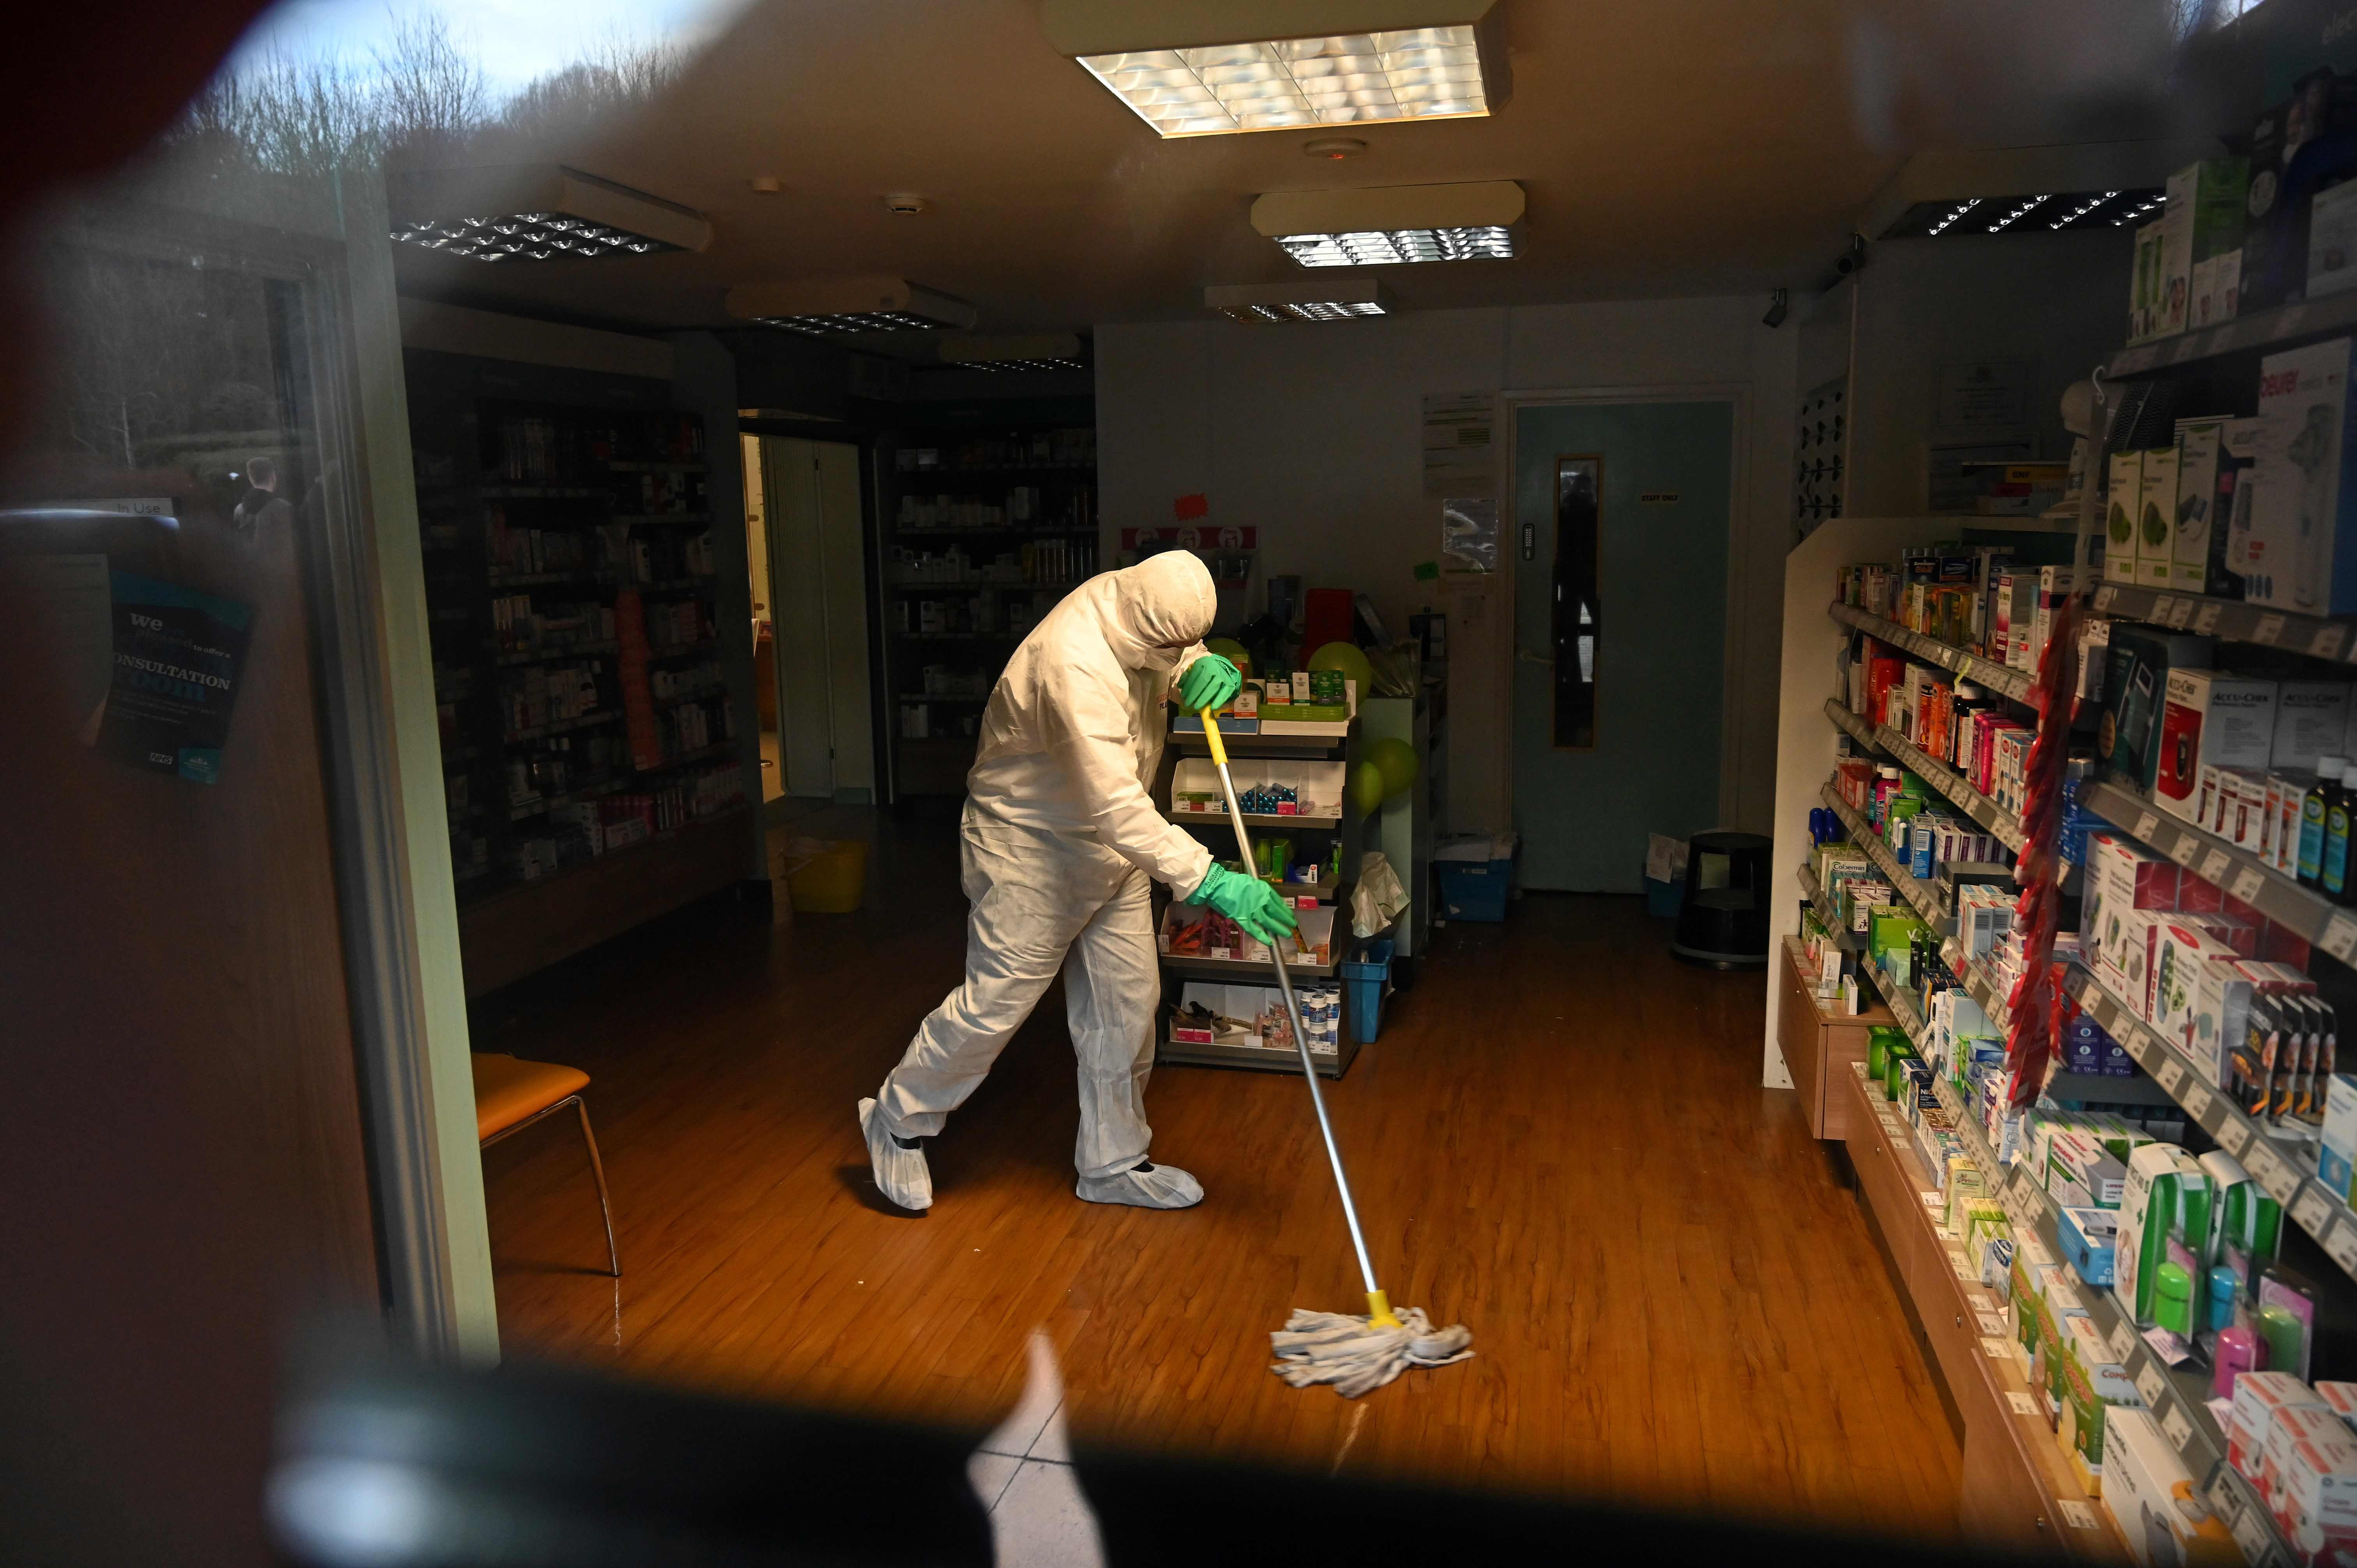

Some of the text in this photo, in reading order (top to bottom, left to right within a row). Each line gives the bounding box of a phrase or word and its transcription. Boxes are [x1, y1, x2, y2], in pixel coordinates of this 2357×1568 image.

[134, 503, 160, 514] Use
[130, 612, 163, 631] we
[203, 646, 224, 657] offer
[113, 653, 231, 690] ONSULTATION
[150, 754, 172, 764] NHS
